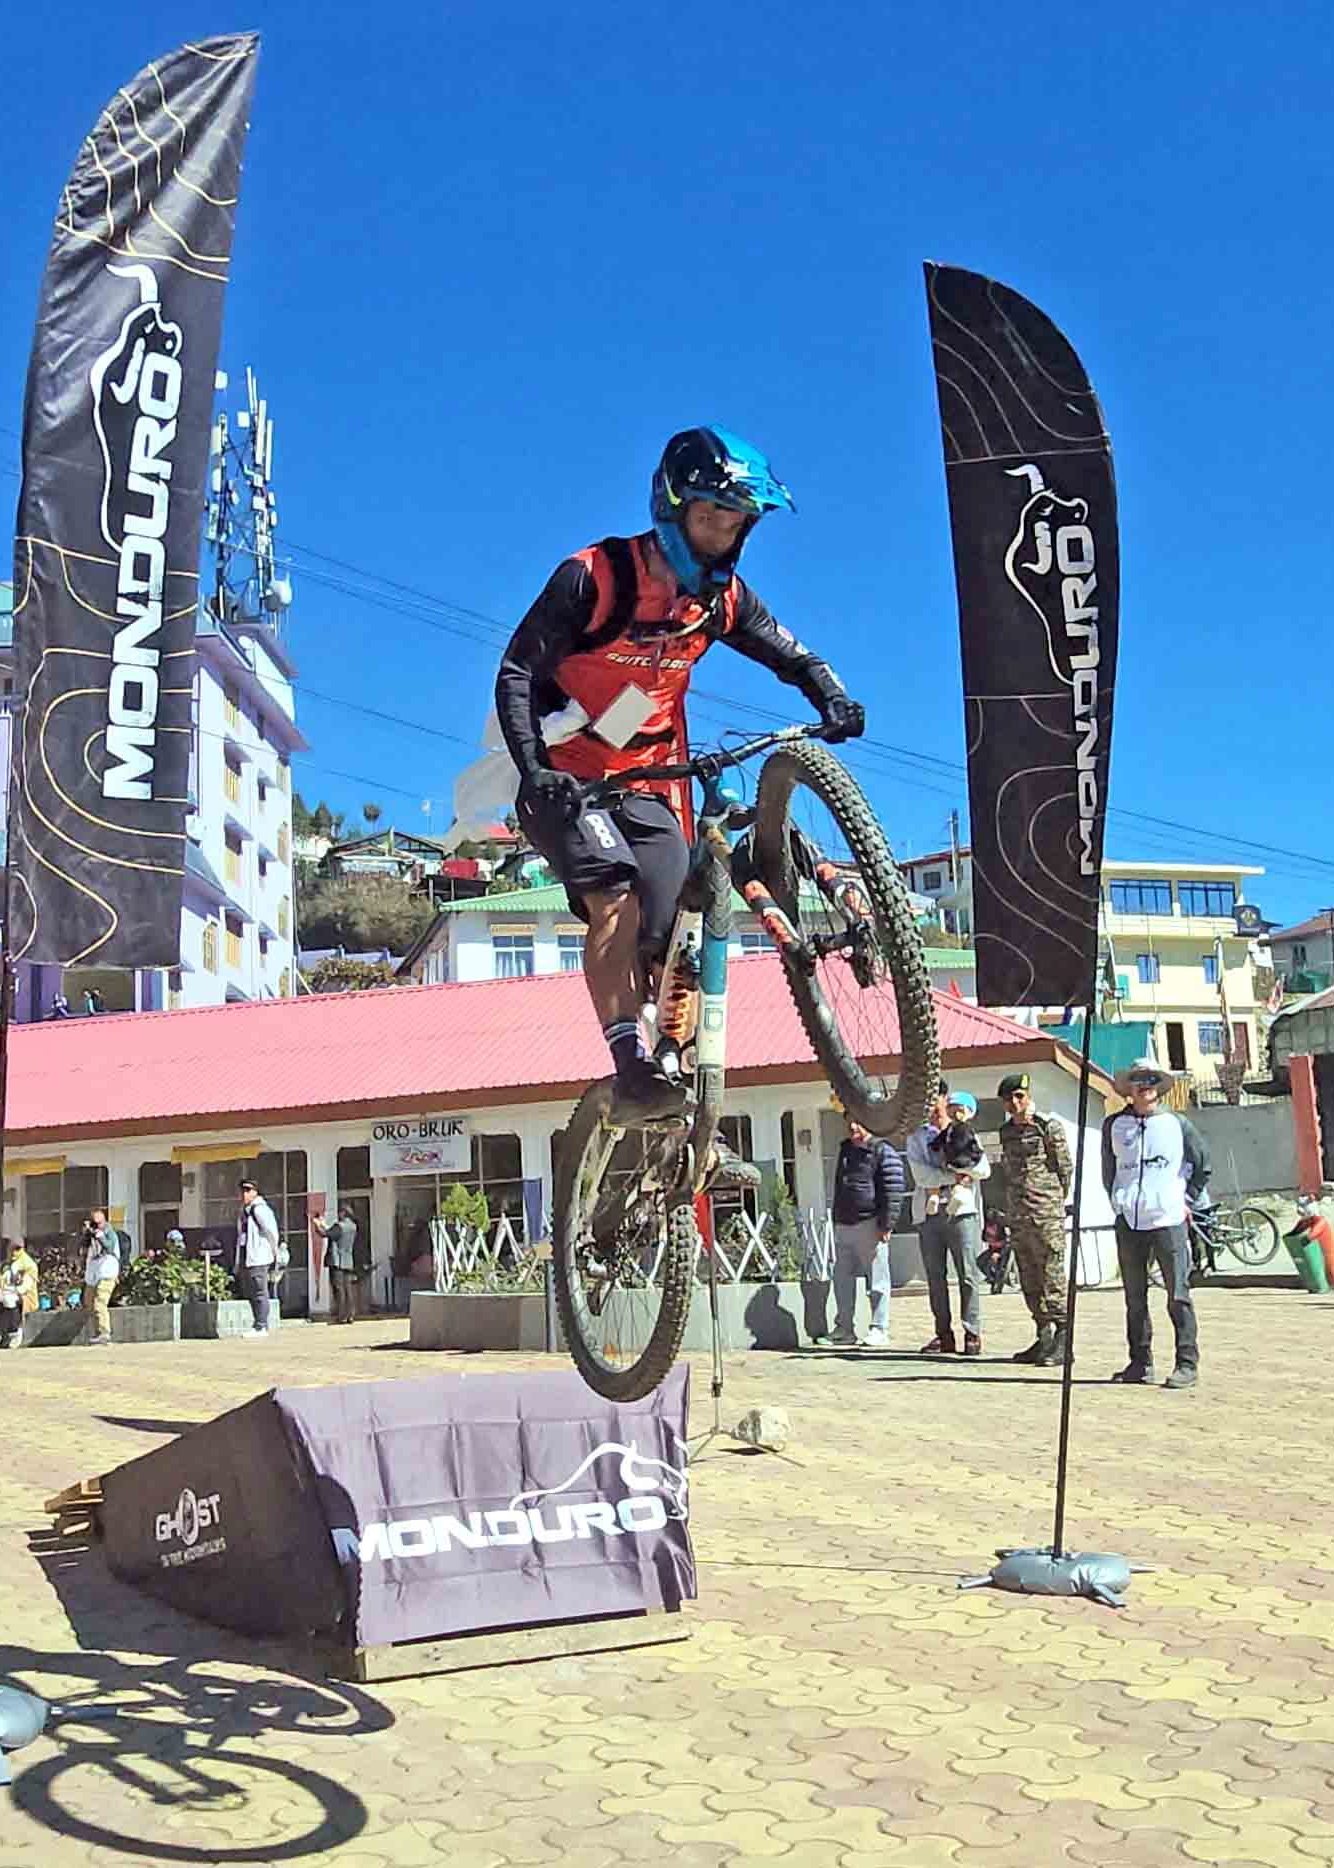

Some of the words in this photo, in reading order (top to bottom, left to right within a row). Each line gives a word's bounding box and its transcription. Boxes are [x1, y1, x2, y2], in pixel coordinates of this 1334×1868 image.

[102, 351, 182, 800] MONDURO
[1055, 525, 1099, 876] MONDURO
[156, 1488, 220, 1546] GHOST
[331, 1495, 668, 1566] MONDURO
